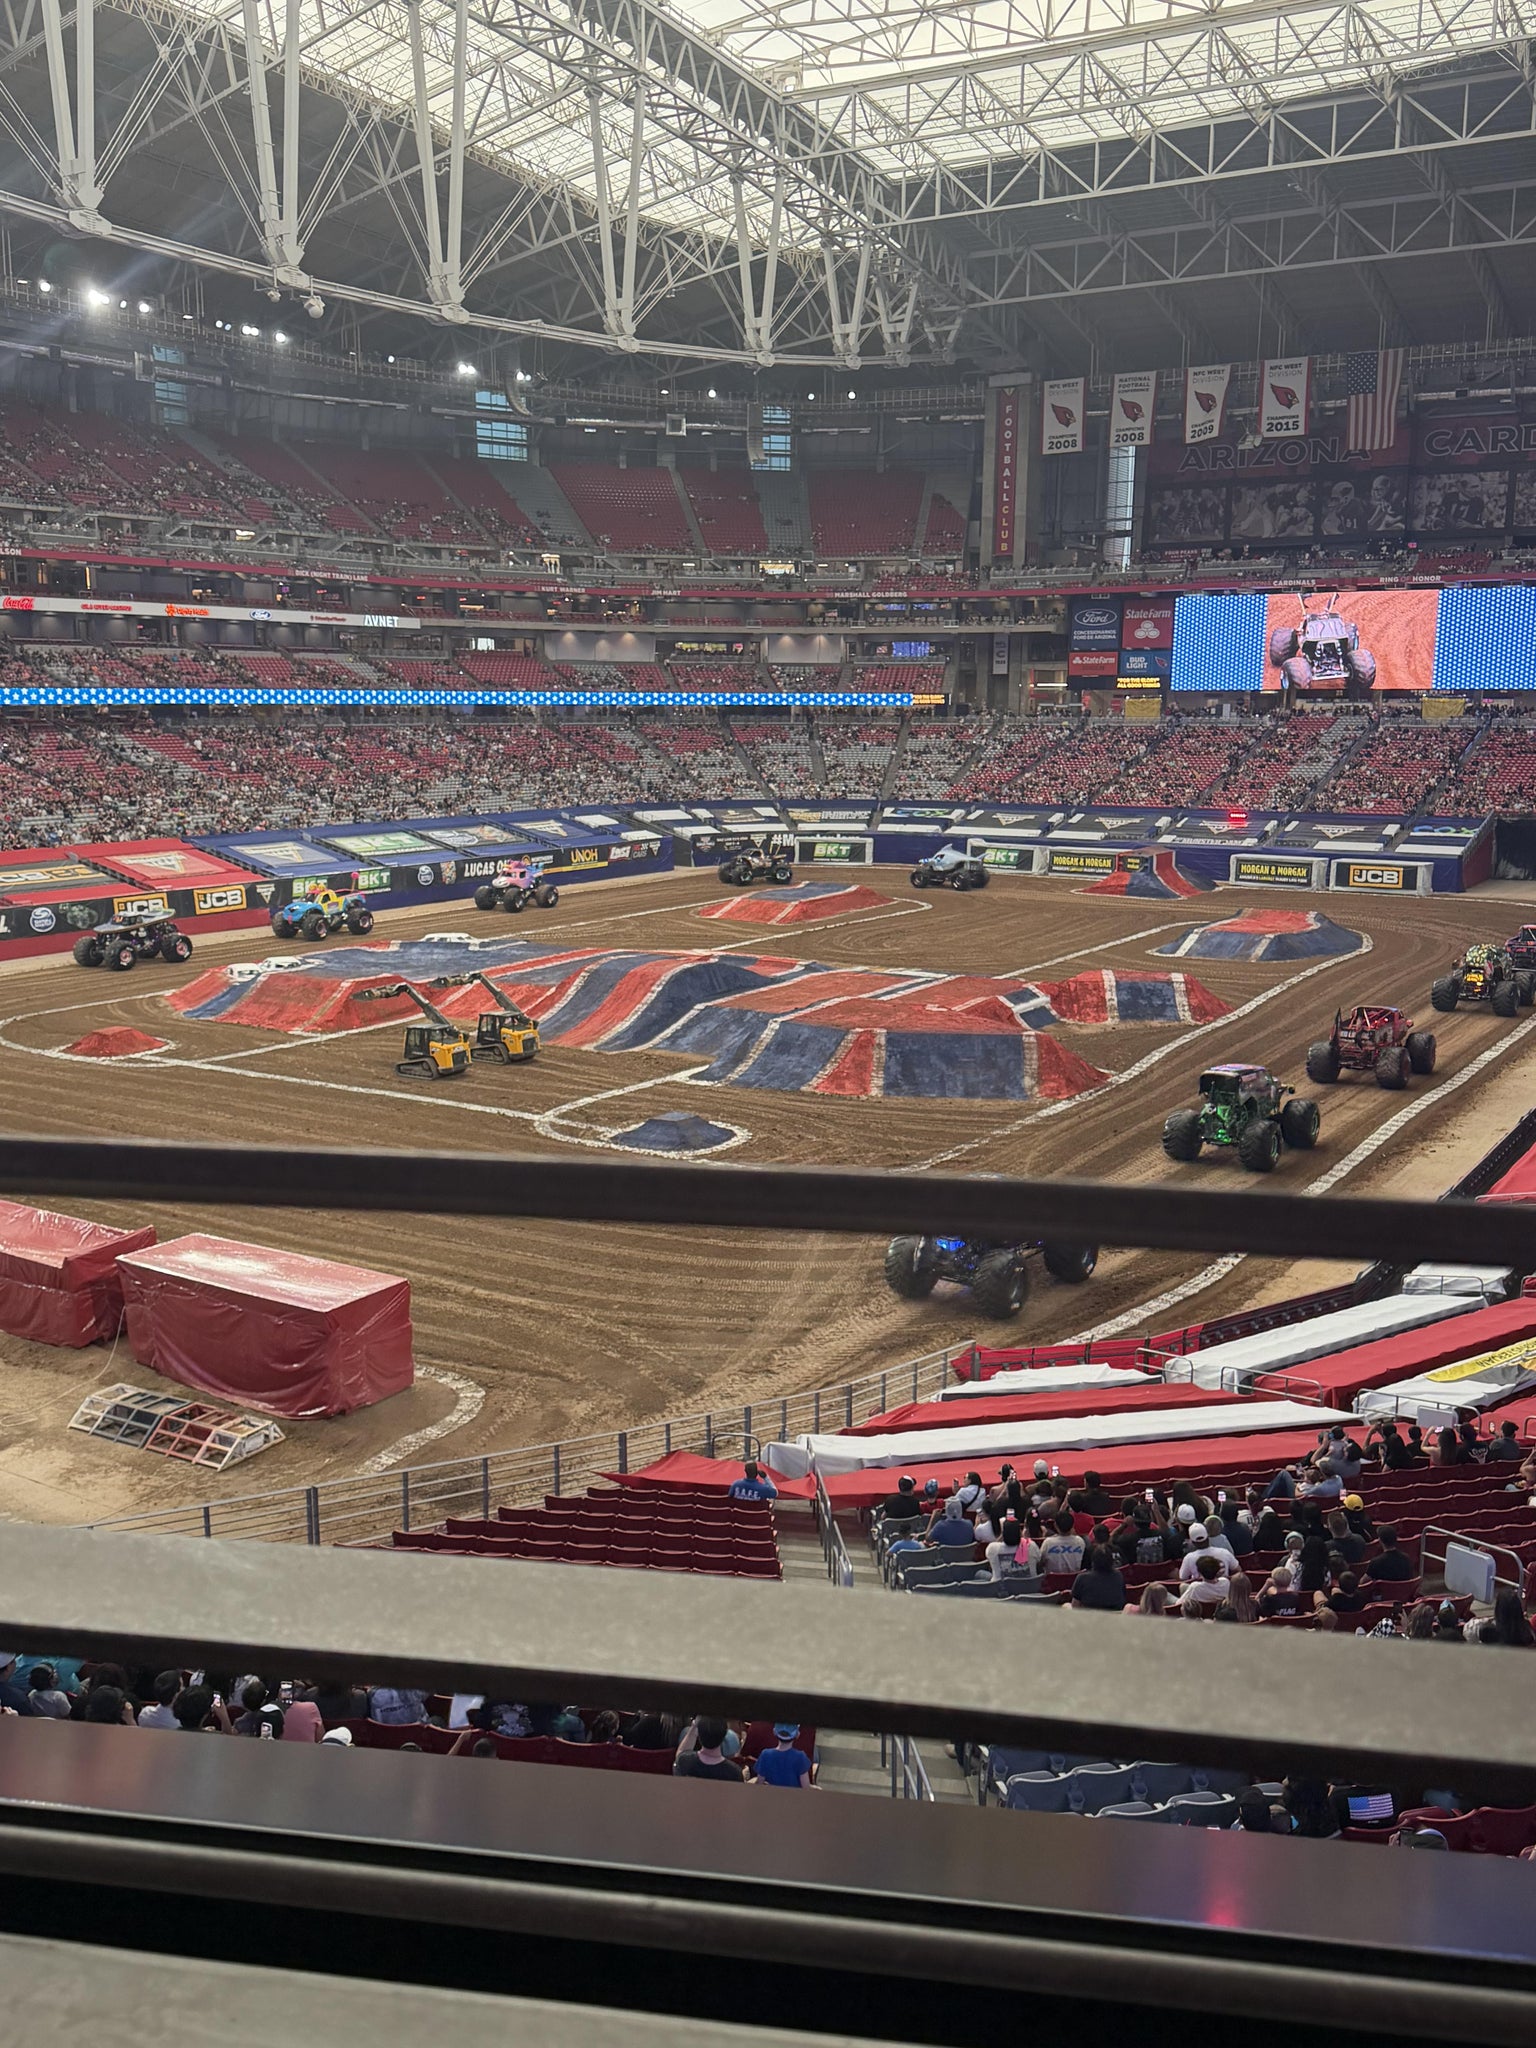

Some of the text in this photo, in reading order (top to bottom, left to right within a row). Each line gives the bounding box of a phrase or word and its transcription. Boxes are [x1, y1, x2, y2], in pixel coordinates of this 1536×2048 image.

[1269, 369, 1302, 378] DIVISION
[1190, 424, 1214, 439] 2009
[1266, 420, 1300, 432] 2015
[1048, 439, 1078, 450] 2008
[1114, 433, 1145, 443] 2008
[1001, 505, 1009, 551] CLUB
[1412, 575, 1441, 583] HONOR
[364, 615, 399, 628] AVNET
[1082, 610, 1109, 623] Ford
[570, 849, 598, 863] UNOH
[814, 843, 851, 857] BKT
[1053, 856, 1112, 868] MORGAN & MORGAN
[464, 862, 495, 877] LUCAS
[1241, 864, 1307, 877] MORGAN & MORGAN
[1353, 869, 1399, 884] JCB
[293, 877, 328, 895] BKT
[359, 872, 391, 886] BKT
[200, 890, 242, 909] JCB
[119, 899, 164, 917] JCB
